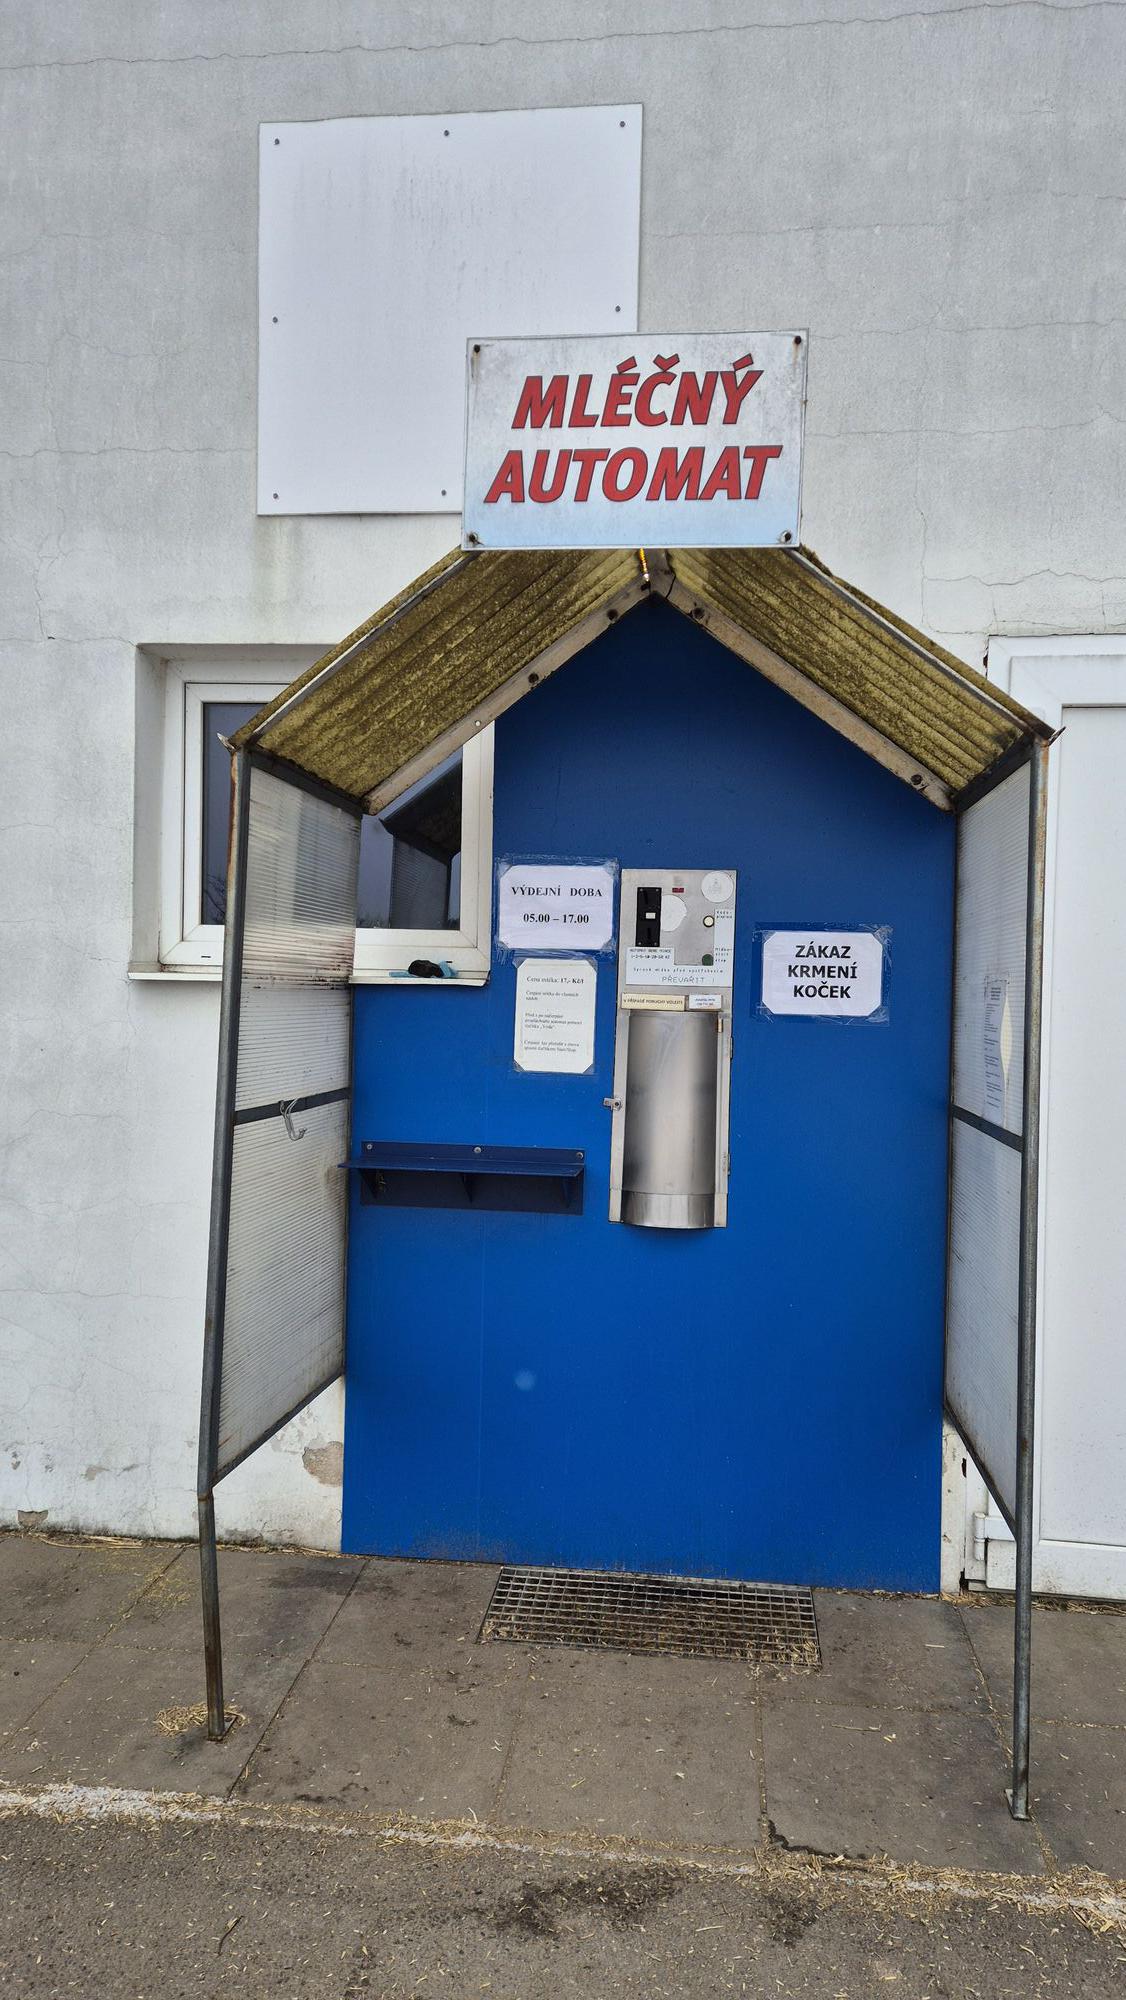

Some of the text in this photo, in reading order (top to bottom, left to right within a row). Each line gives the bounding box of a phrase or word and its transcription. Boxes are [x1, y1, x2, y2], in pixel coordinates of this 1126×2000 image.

[511, 353, 764, 429] MLÉČNÝ
[483, 445, 783, 503] AUTOMAT
[511, 885, 602, 897] VÝDEJNÍ DOBA
[523, 913, 550, 923] 05.00
[563, 914, 589, 923] 17.00
[795, 941, 851, 959] ZÁKAZ
[788, 962, 858, 979] KRMENÍ
[661, 975, 705, 984] PŘEVAŘIT
[793, 981, 851, 998] KOČEK
